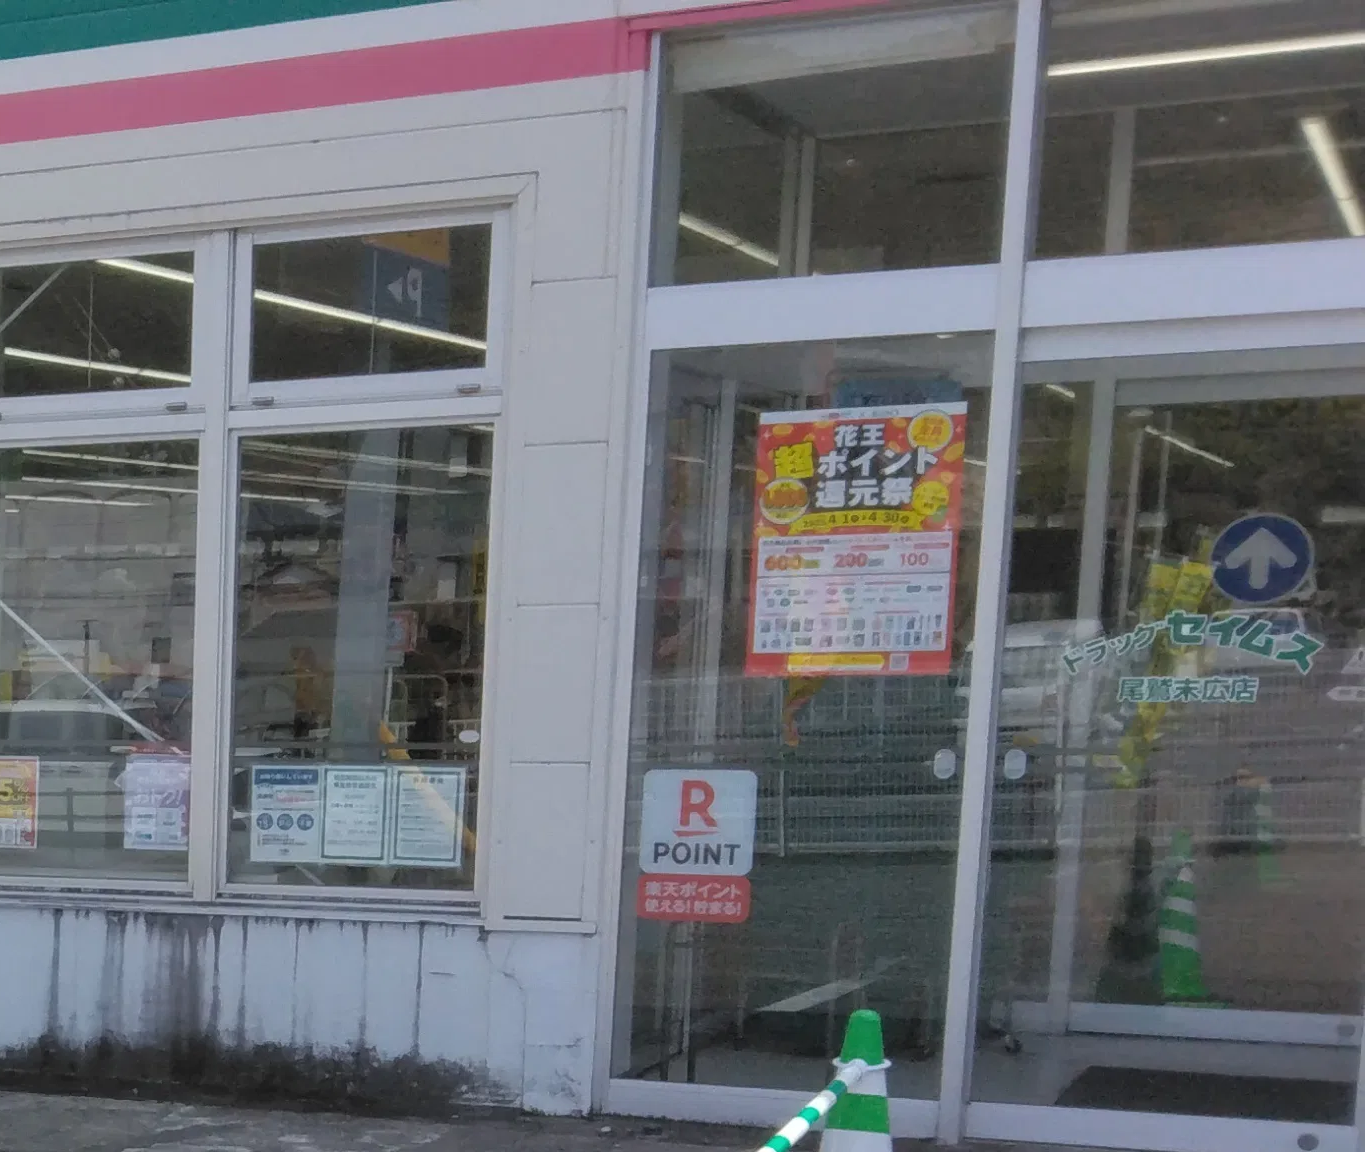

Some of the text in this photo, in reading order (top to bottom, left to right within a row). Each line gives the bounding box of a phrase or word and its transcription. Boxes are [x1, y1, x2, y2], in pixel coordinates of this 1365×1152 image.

[834, 424, 886, 447] 花王
[817, 447, 938, 478] ポイント
[815, 476, 913, 509] 還元祭
[900, 552, 929, 566] 100
[1062, 610, 1324, 675] ドラッグ セイムス
[1119, 676, 1259, 703] 尾鷲末広店
[679, 780, 718, 828] R
[653, 842, 741, 865] POINT
[645, 880, 743, 899] 楽天ポイント
[644, 899, 690, 913] 使える!
